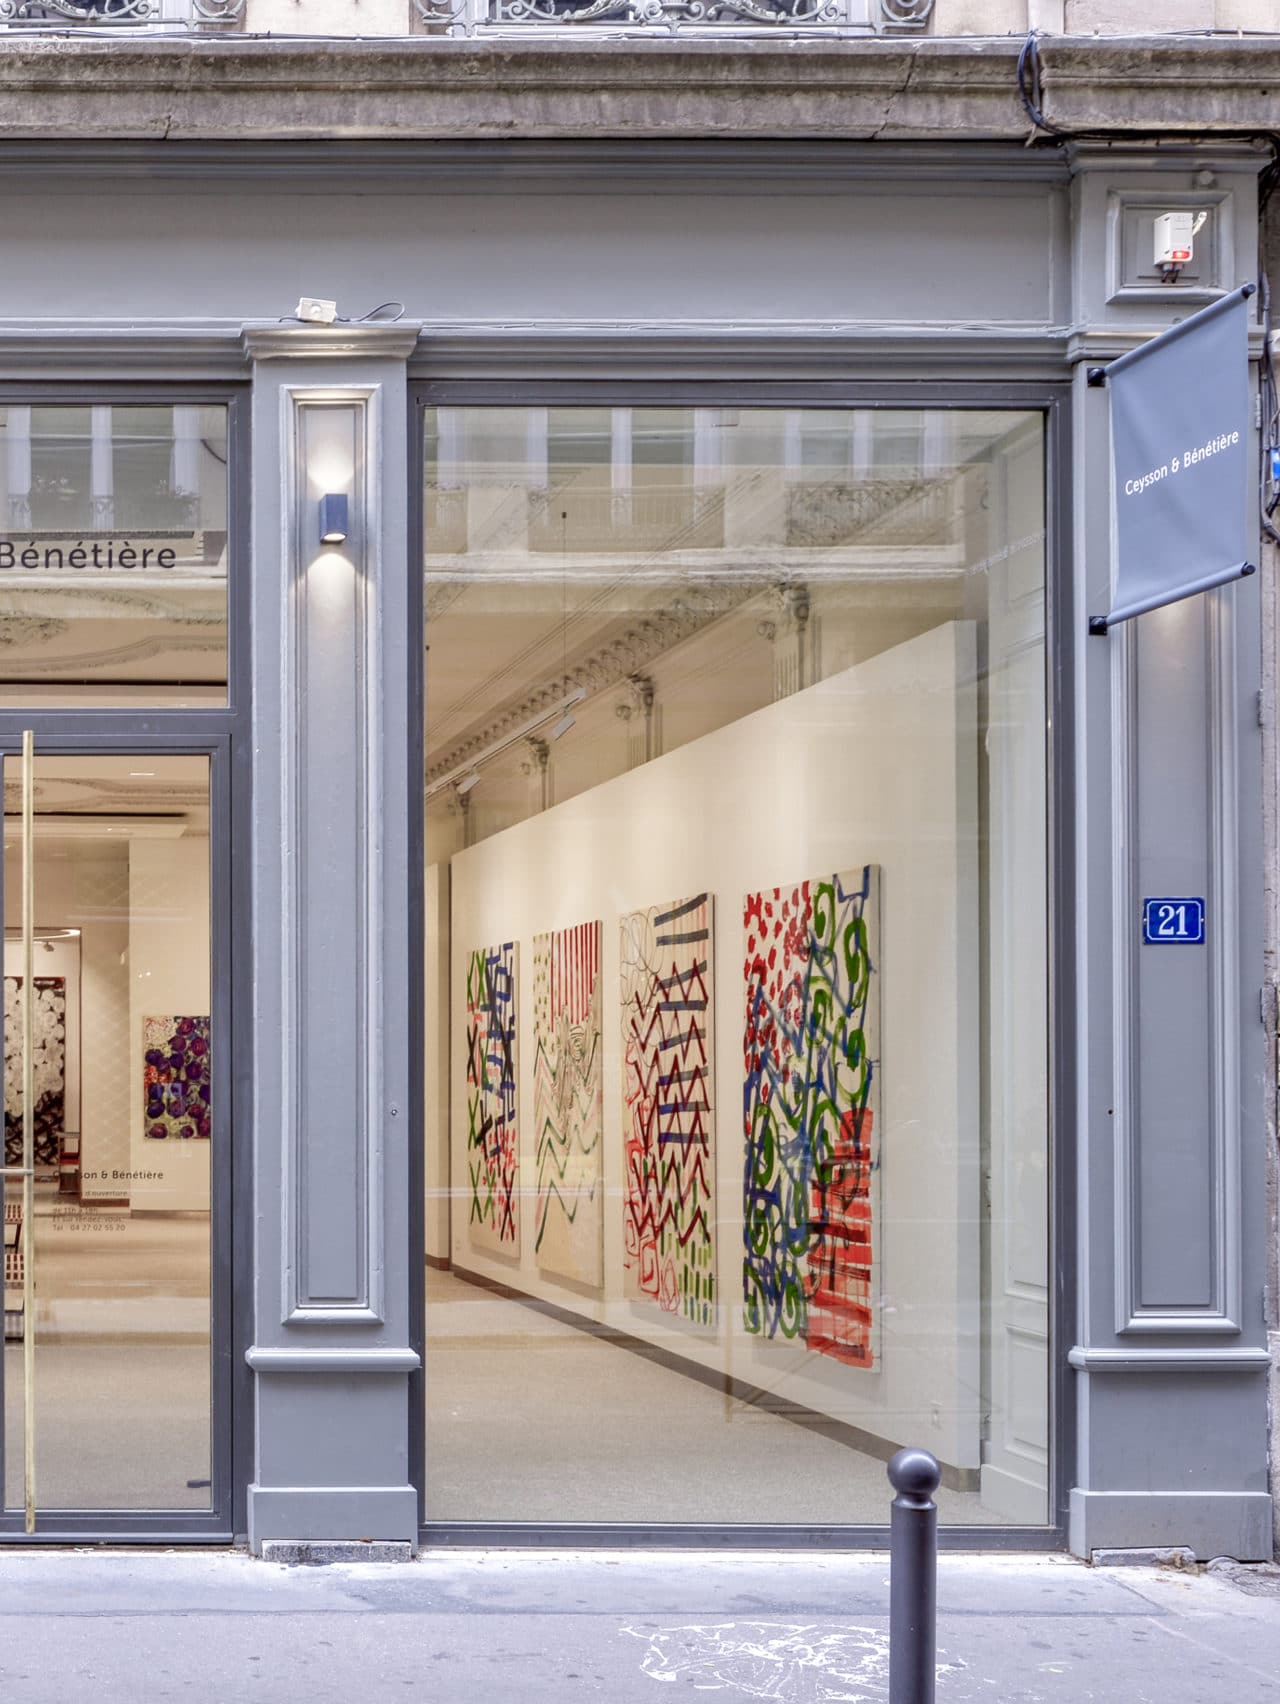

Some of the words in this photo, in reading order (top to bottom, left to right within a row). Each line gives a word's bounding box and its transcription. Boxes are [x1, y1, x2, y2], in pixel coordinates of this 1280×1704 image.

[1124, 465, 1168, 495] Ceysson
[1171, 457, 1180, 473] &
[1183, 431, 1239, 468] Bénétière
[1158, 905, 1188, 935] 21
[101, 1170, 108, 1179] &
